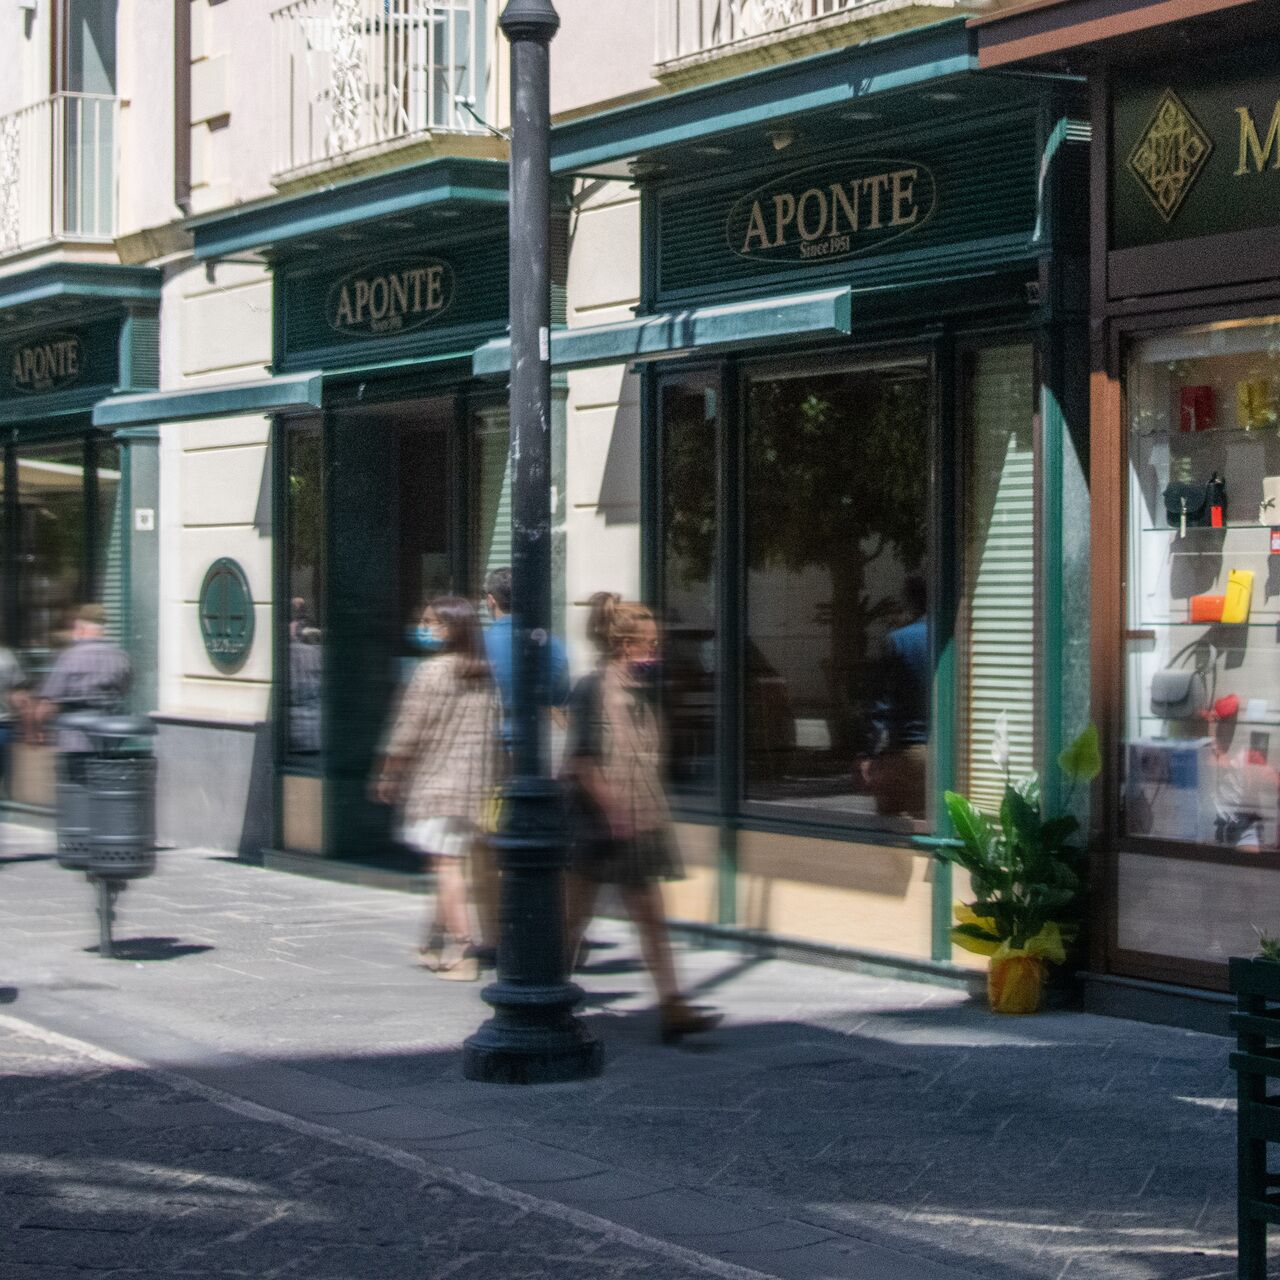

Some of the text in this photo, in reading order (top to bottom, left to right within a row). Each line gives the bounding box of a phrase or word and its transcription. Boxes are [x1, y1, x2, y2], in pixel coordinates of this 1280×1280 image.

[740, 167, 919, 253] APONTE
[799, 241, 829, 259] Since
[335, 265, 444, 326] APONTE
[12, 339, 79, 383] APONTE
